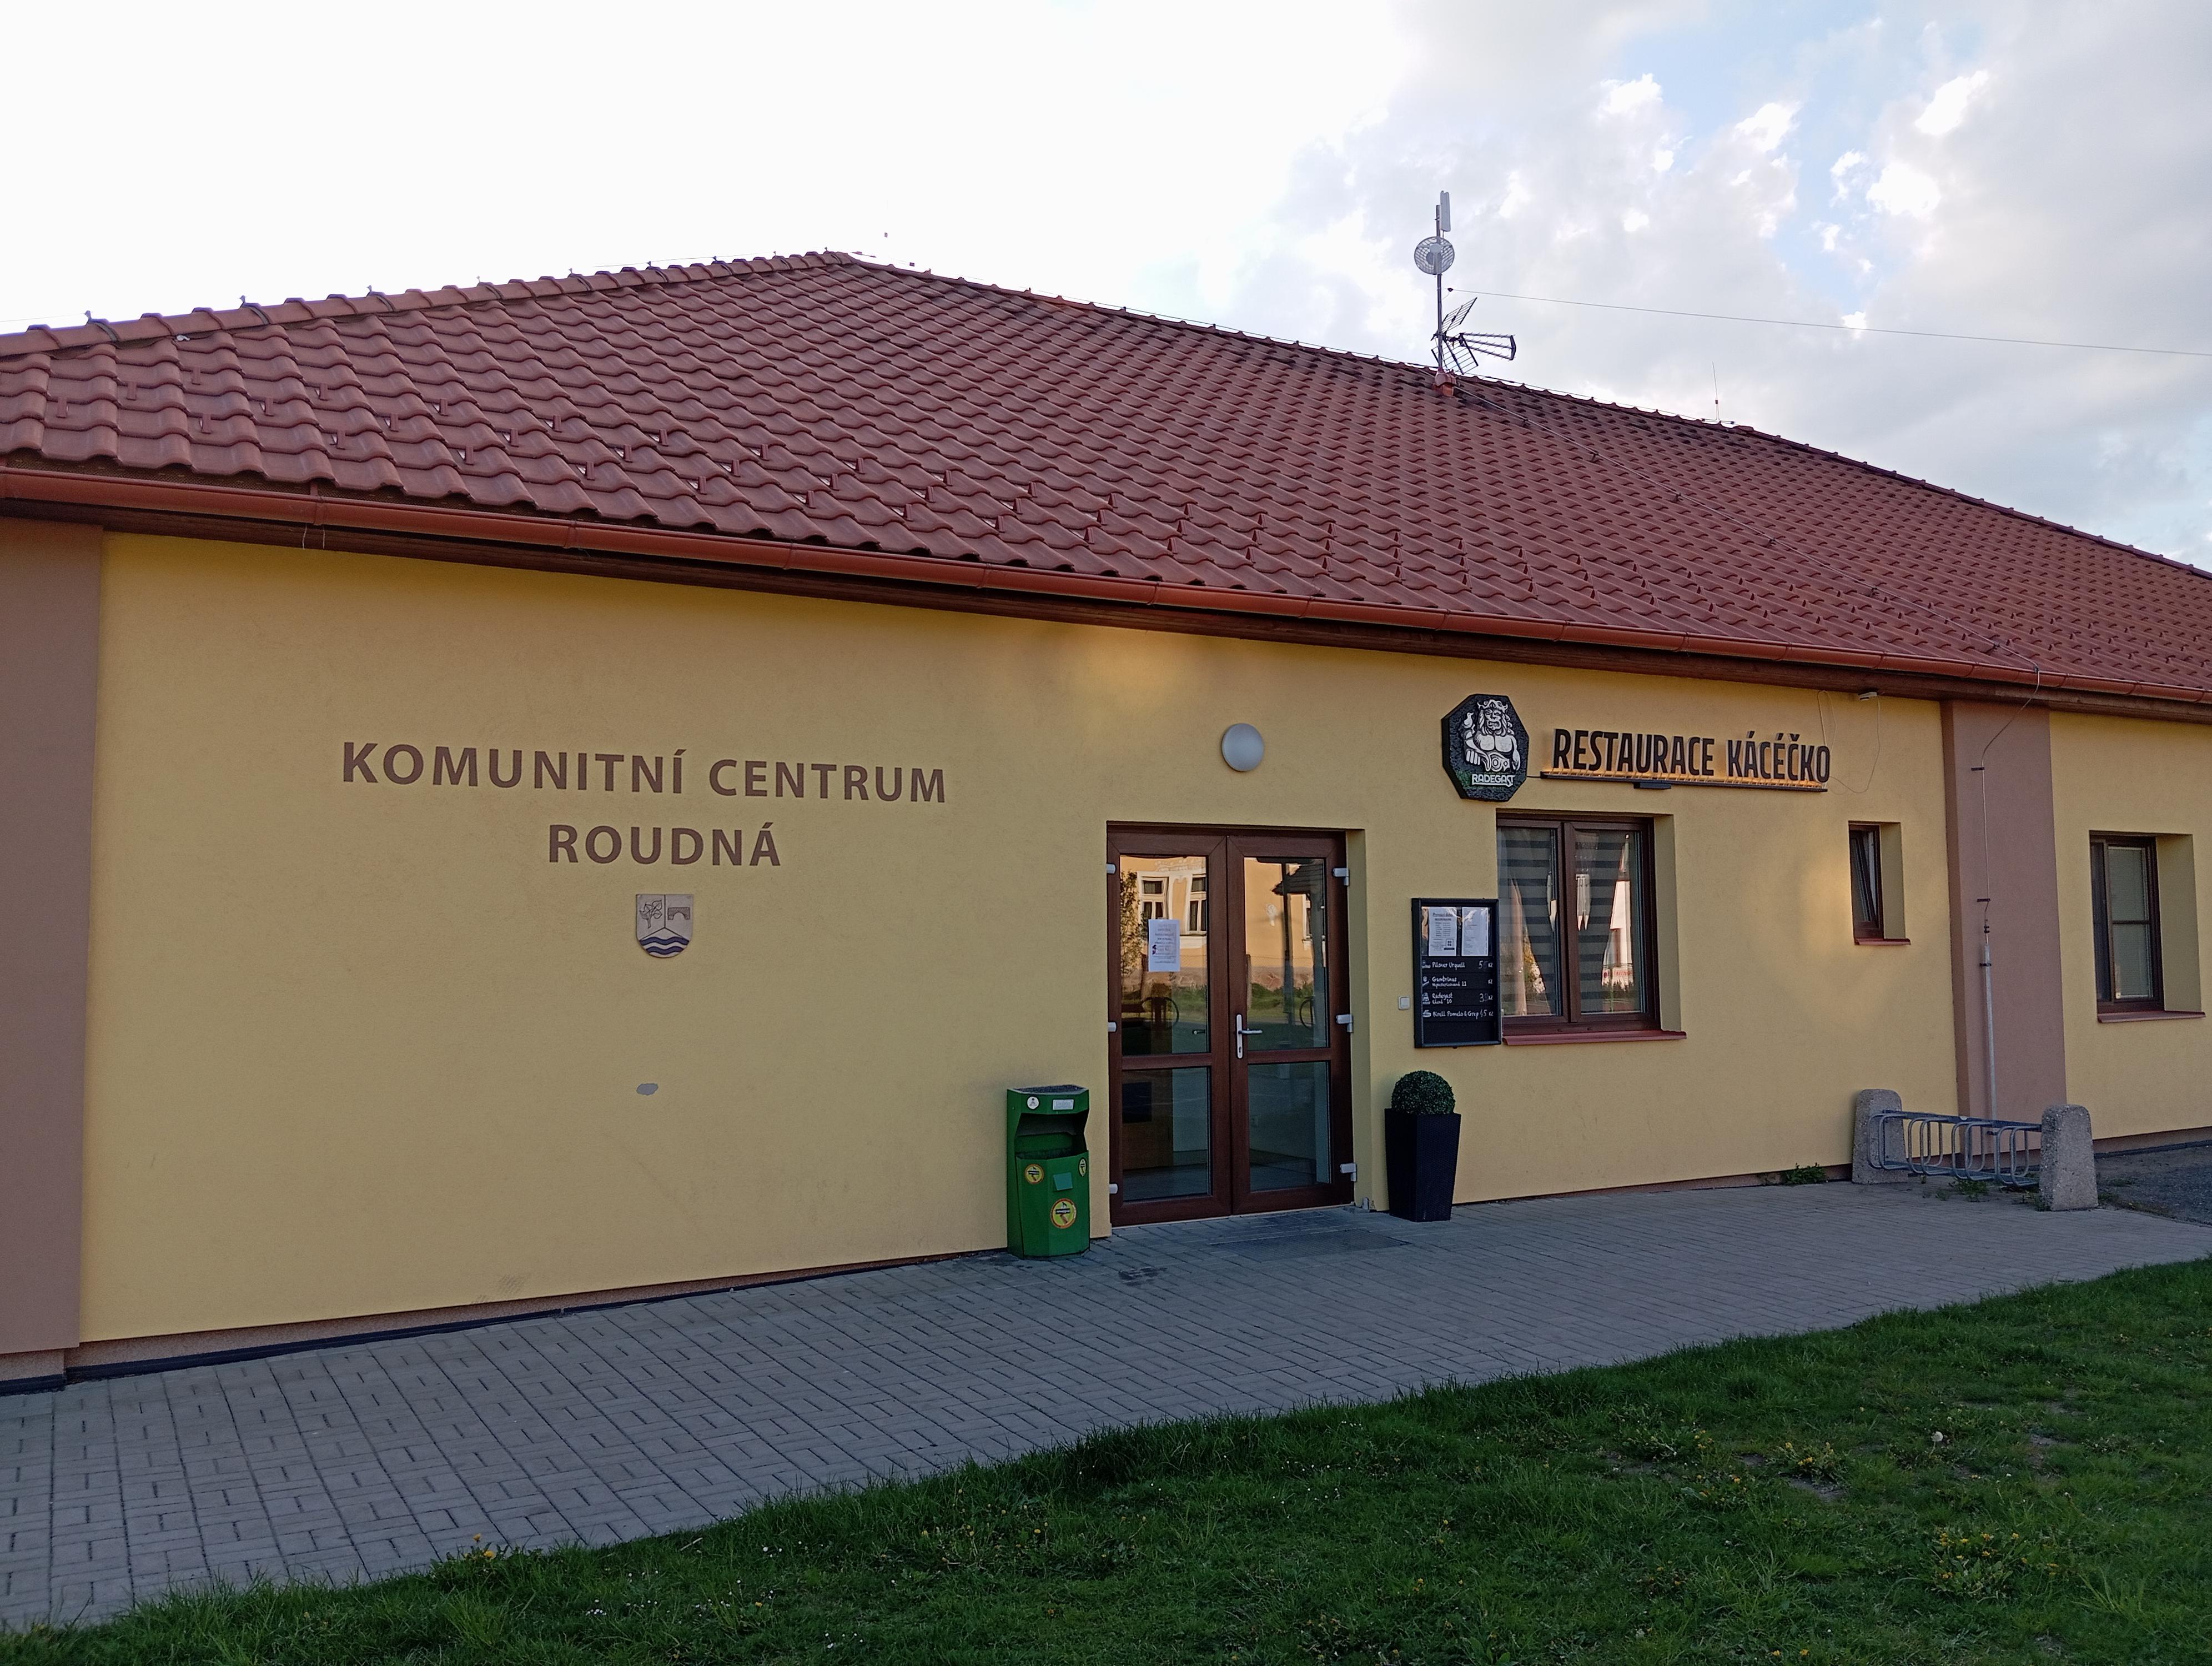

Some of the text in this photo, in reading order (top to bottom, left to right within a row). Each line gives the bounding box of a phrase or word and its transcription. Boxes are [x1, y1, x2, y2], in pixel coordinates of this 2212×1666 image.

[344, 742, 944, 802] KOMUNITNÍ CENTRUM
[1553, 728, 1831, 783] RESTAURACE KÁCÉČKO
[1471, 774, 1516, 787] RADEGAST
[549, 822, 780, 866] ROUDNÁ
[1449, 961, 1465, 970] Urquell
